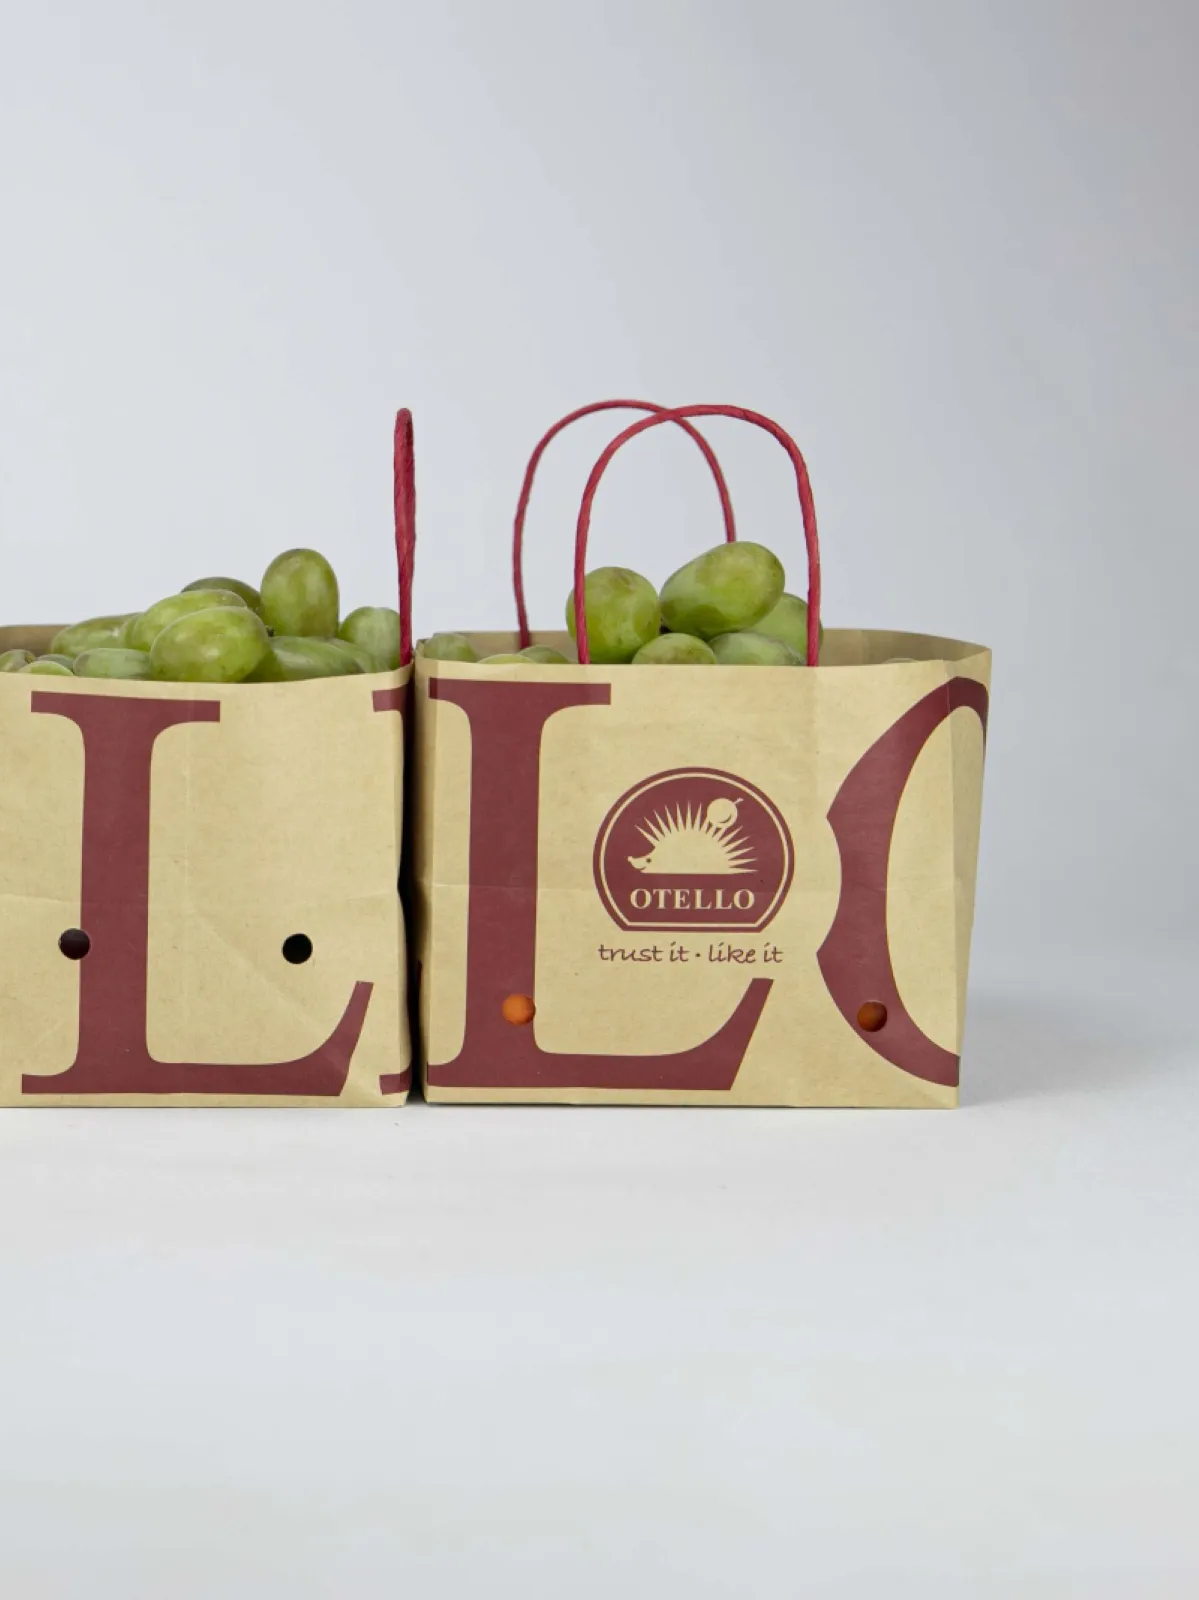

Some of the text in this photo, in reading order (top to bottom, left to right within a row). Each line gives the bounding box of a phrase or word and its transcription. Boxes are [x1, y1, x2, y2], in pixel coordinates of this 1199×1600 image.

[629, 888, 756, 910] OTELLO
[598, 943, 664, 962] trust
[669, 941, 690, 962] it
[708, 941, 757, 964] like
[763, 941, 784, 963] it
